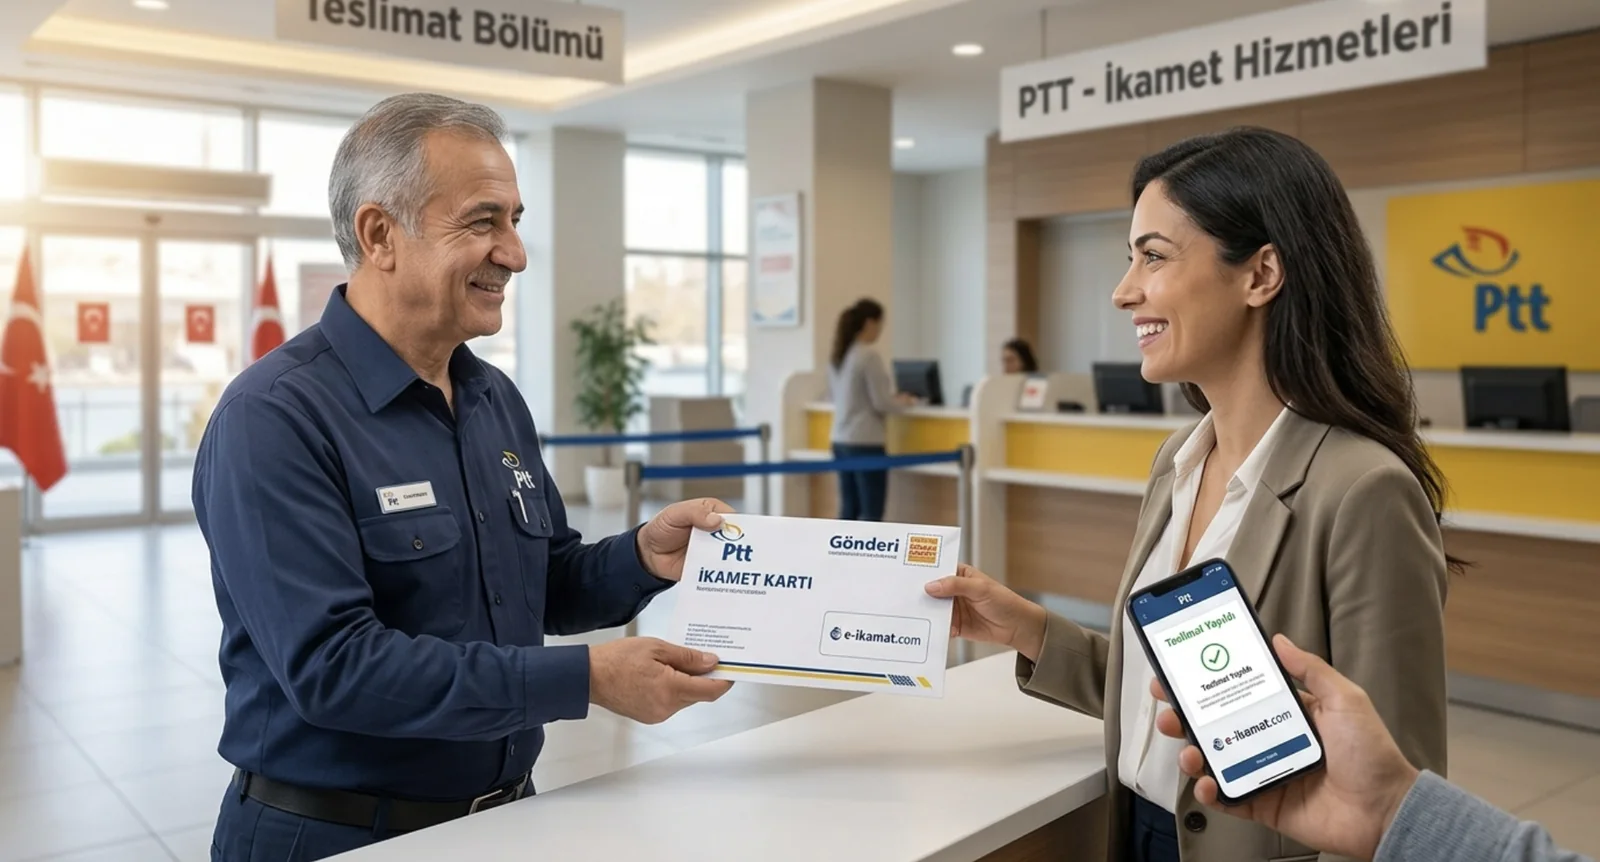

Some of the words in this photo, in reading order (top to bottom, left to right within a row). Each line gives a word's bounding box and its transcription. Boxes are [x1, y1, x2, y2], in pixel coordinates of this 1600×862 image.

[473, 10, 605, 60] Bölümü
[1018, 77, 1075, 119] PTT
[1105, 50, 1223, 104] İkamet
[1234, 2, 1452, 80] Hizmetleri
[1474, 283, 1552, 334] Ptt
[722, 542, 754, 562] Ptt
[829, 535, 900, 553] Gönderi
[698, 567, 762, 587] İKAMET
[763, 573, 813, 590] KARTI
[844, 629, 921, 646] e-ikamat.com
